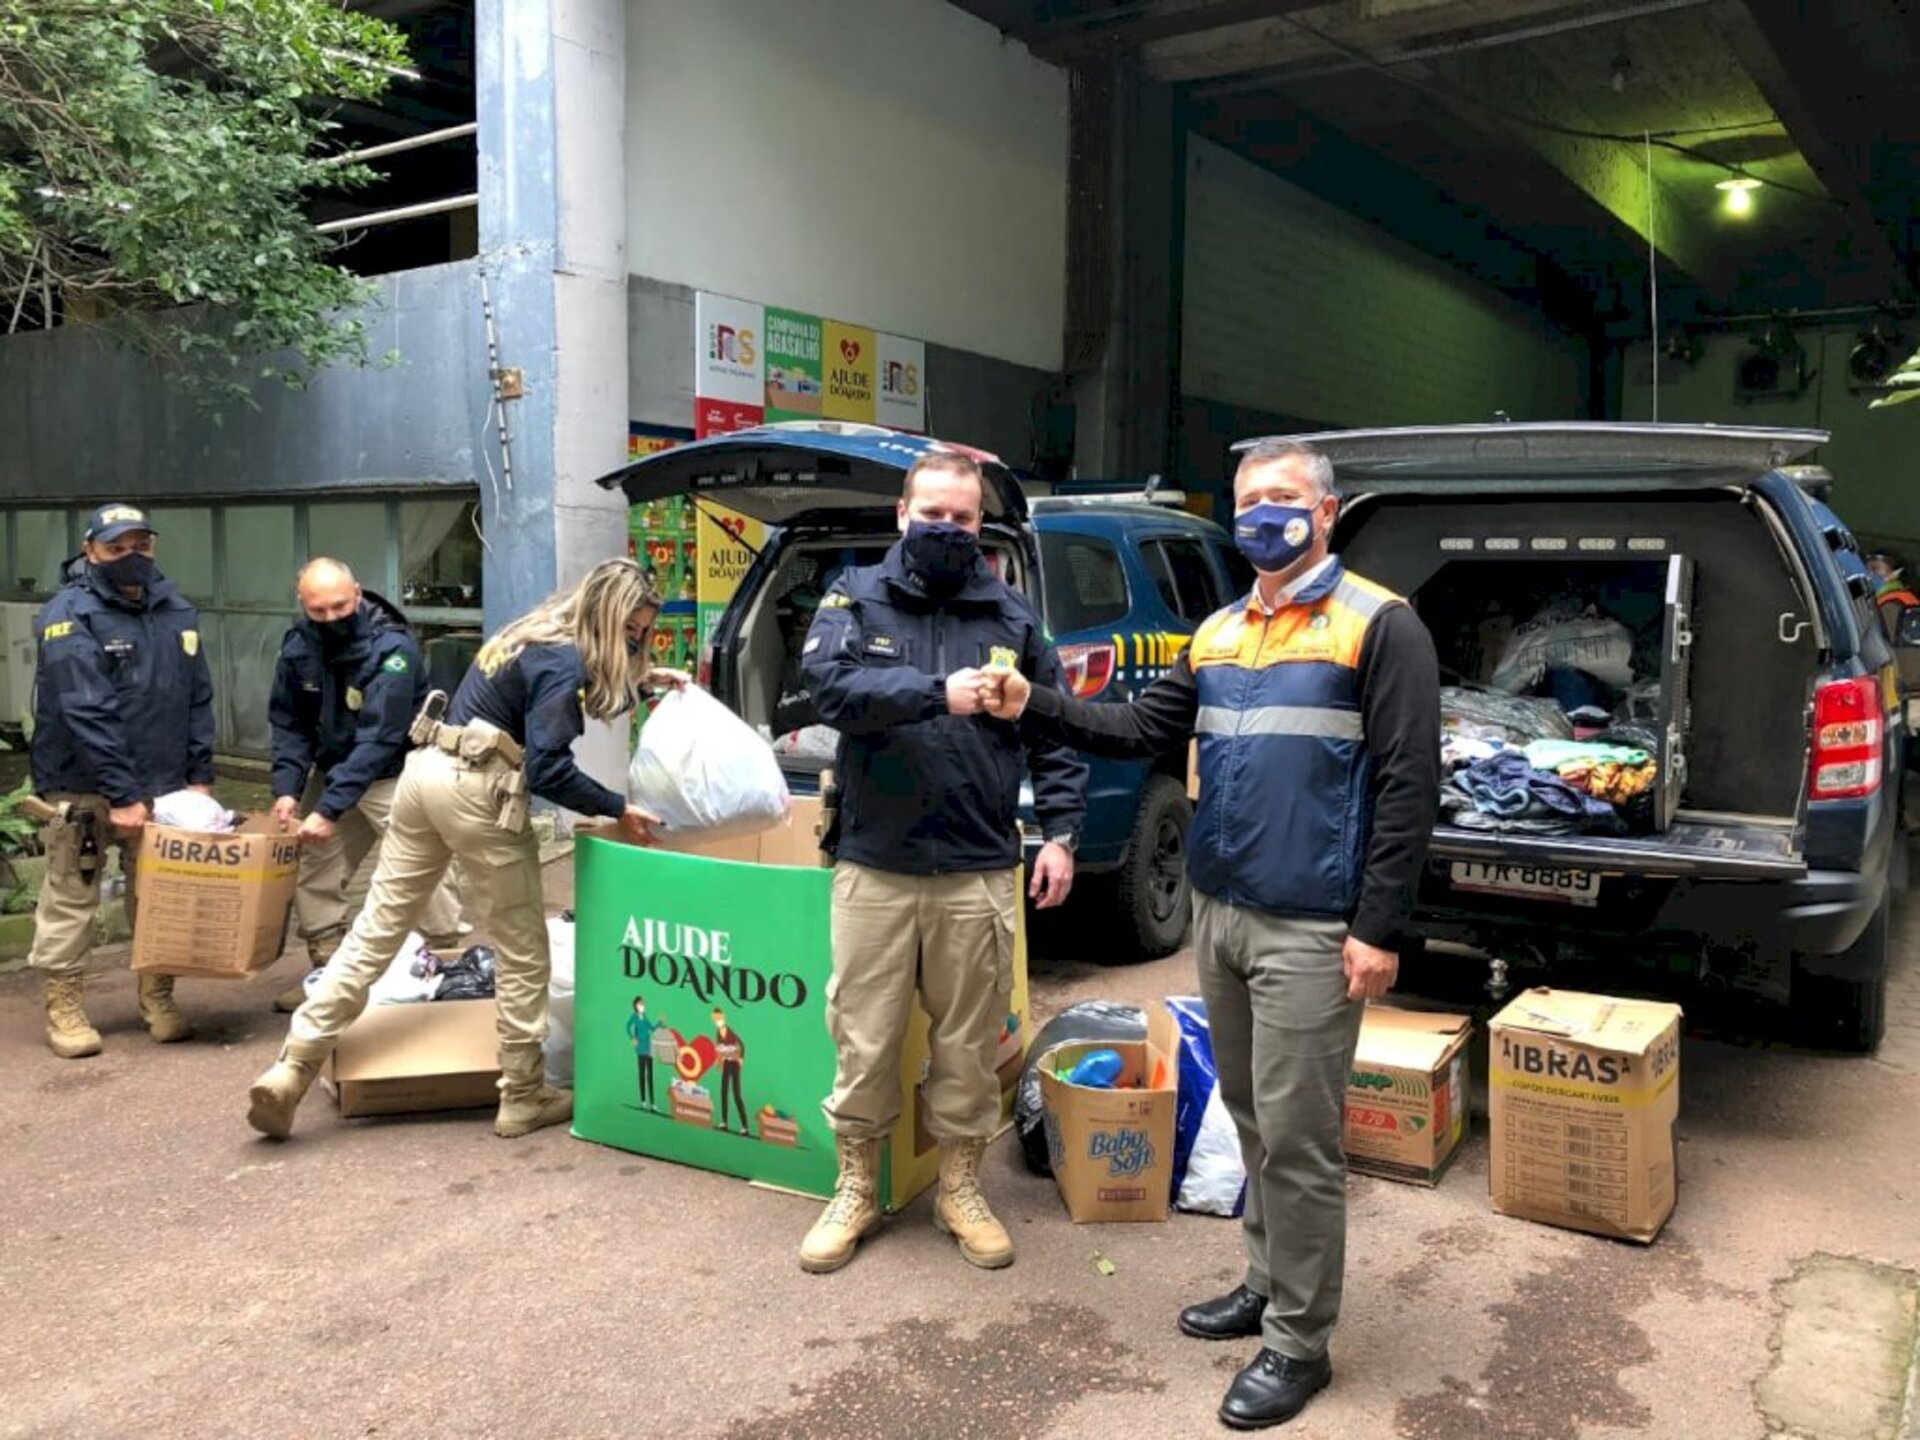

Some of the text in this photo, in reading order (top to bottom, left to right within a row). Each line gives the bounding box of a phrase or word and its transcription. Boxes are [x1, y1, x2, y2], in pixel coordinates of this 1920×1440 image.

[830, 367, 869, 387] AJUDE
[160, 838, 242, 866] IBRAS
[621, 914, 732, 965] AJUDE
[618, 944, 809, 1010] DOANDO
[1512, 1043, 1619, 1085] IBRAS
[1088, 1127, 1148, 1158] Baby
[1109, 1142, 1154, 1174] Soft
